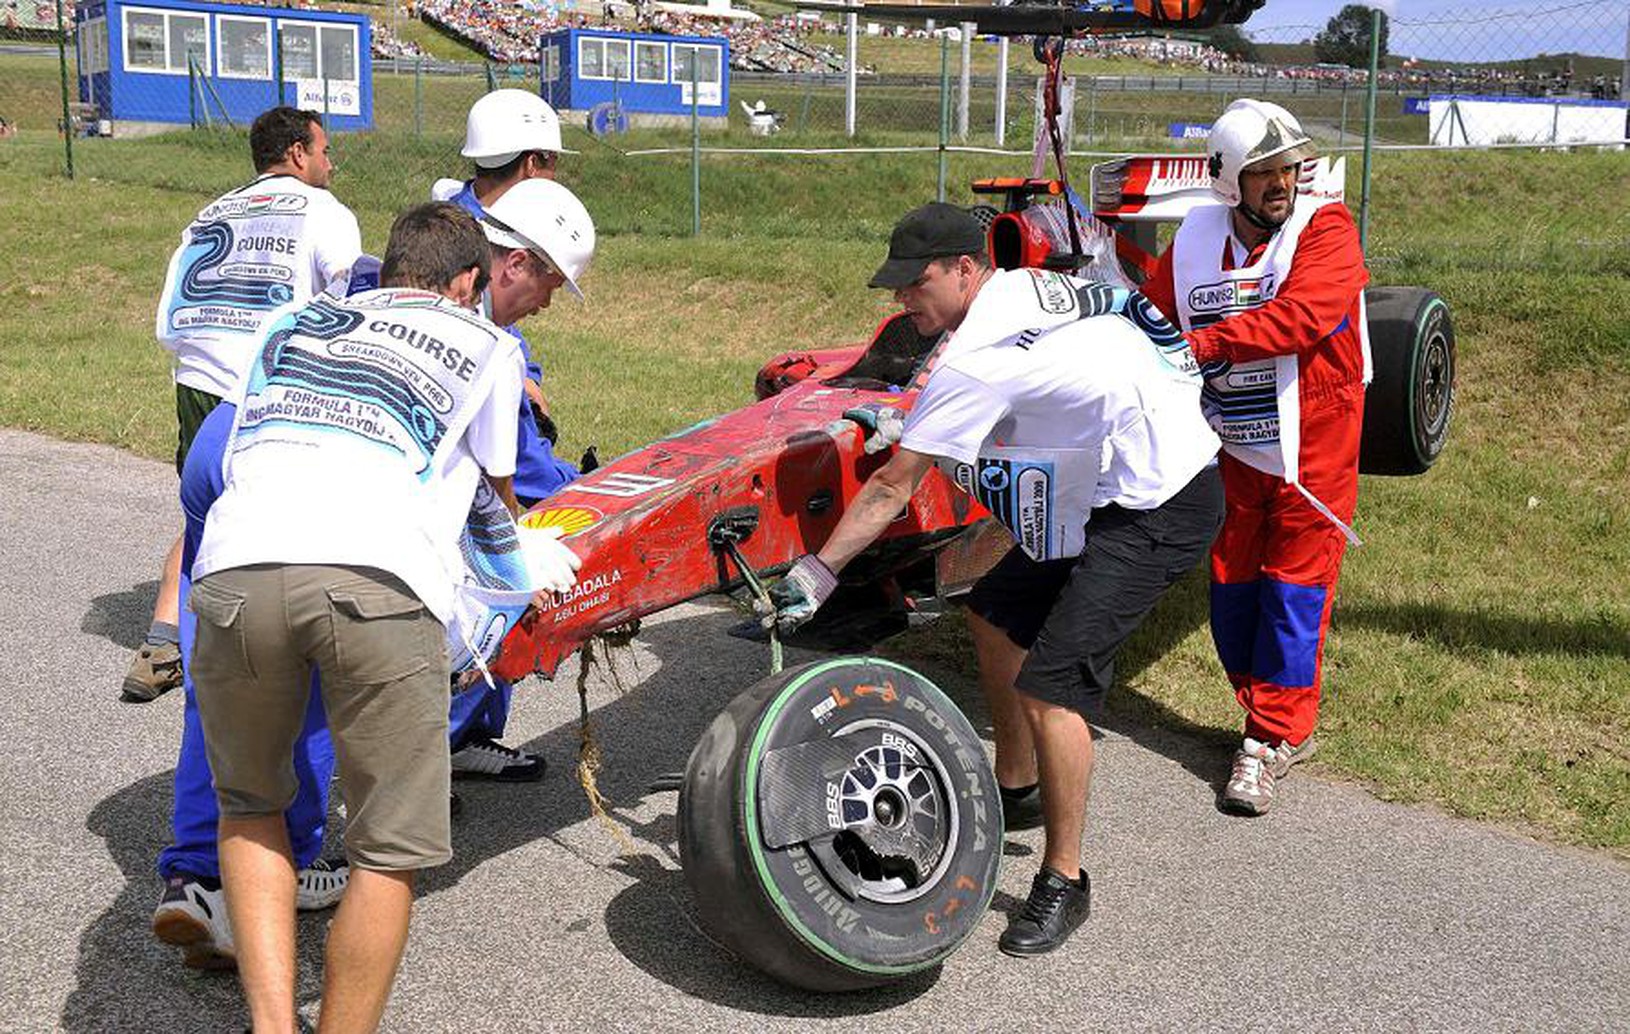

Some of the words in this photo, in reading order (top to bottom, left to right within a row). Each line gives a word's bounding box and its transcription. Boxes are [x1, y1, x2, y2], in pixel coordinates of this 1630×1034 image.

[237, 236, 297, 255] COURSE
[369, 320, 477, 382] COURSE
[283, 390, 351, 414] FORMULA
[881, 731, 919, 760] BBS
[904, 694, 988, 853] POTENZA
[826, 781, 841, 828] BBS
